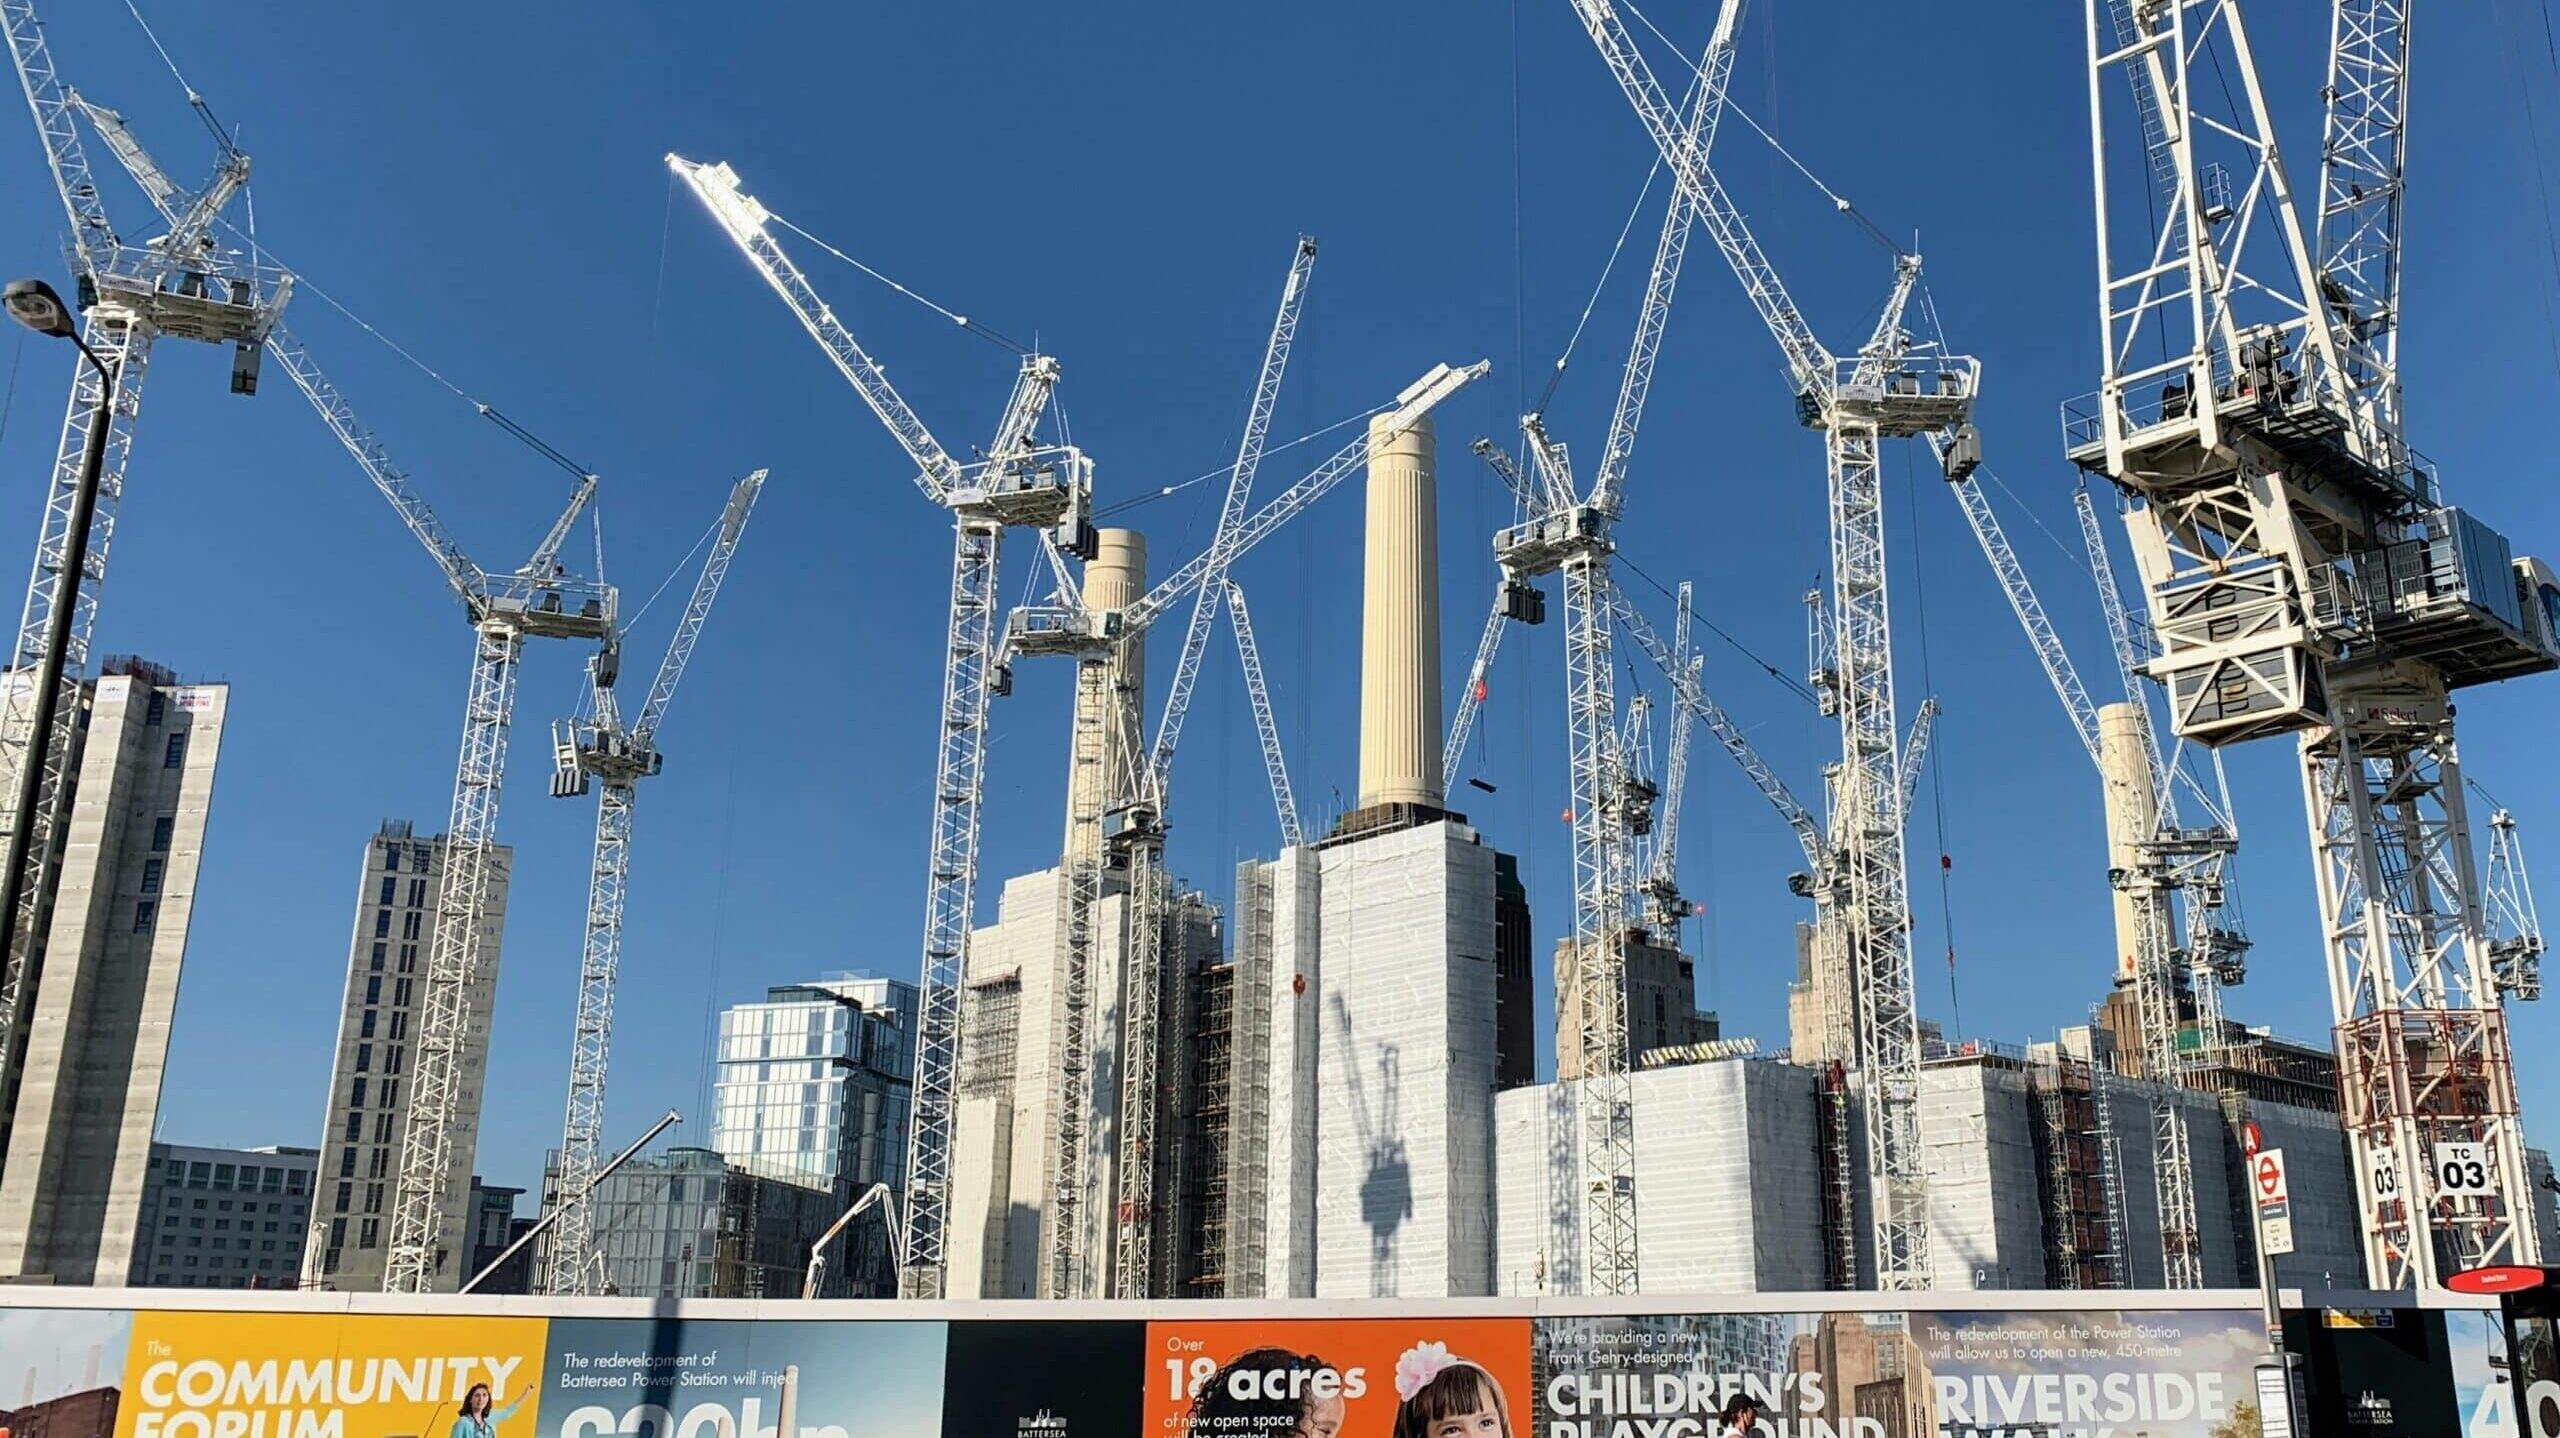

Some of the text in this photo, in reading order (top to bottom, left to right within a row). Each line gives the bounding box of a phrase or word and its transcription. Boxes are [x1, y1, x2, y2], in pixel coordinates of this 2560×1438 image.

[2246, 1126, 2257, 1151] A
[2377, 1154, 2386, 1165] TC
[2451, 1148, 2470, 1159] TC
[2375, 1166, 2395, 1195] 03
[2443, 1162, 2485, 1189] 03
[1549, 1329, 1698, 1347] We're providing a new
[1928, 1325, 2181, 1343] The redevelopment of the Power Station
[146, 1340, 172, 1356] The
[1167, 1337, 1204, 1351] Over
[1929, 1344, 2182, 1361] will allow us to open a new, 450-metre
[564, 1350, 717, 1371] The redevelopment of
[1549, 1348, 1693, 1367] Frank Gehry-designed
[140, 1356, 523, 1408] COMMUNITY
[561, 1373, 626, 1388] Battersea
[632, 1372, 676, 1386] Power
[680, 1371, 727, 1386] Station
[733, 1370, 756, 1386] will
[1166, 1357, 1367, 1401] 18 acres
[1934, 1372, 2226, 1424] RIVERSIDE
[133, 1408, 343, 1438] FORUM
[1164, 1411, 1294, 1431] of new open space
[1018, 1429, 1066, 1438] BATTERSEA
